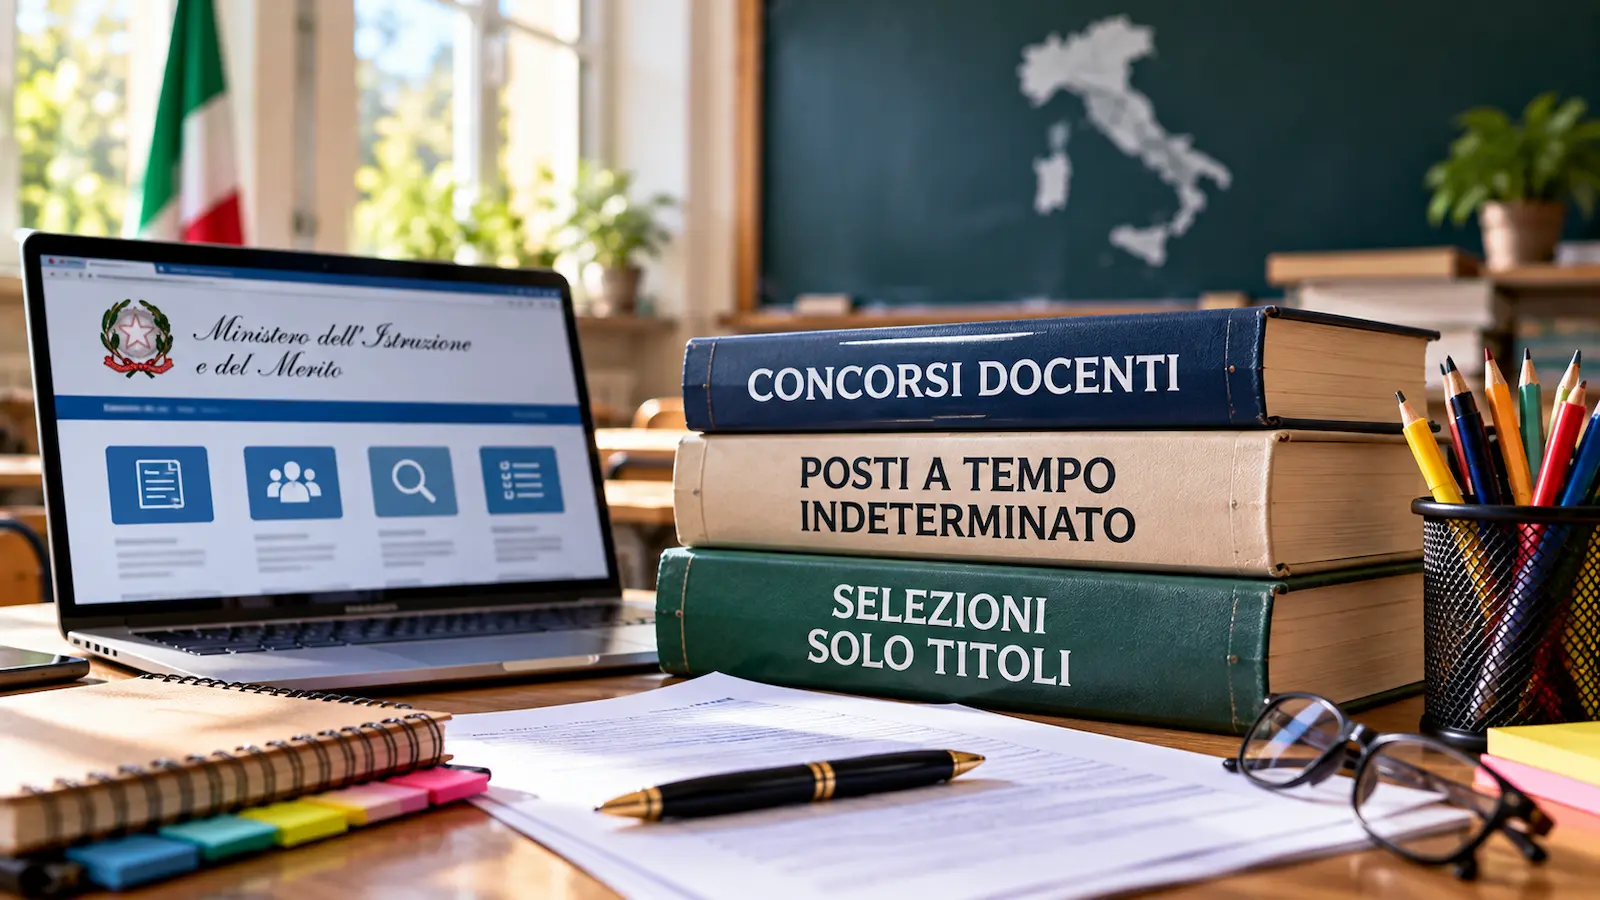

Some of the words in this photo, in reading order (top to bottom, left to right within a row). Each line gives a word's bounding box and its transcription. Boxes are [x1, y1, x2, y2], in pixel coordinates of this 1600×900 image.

[192, 314, 310, 346] Ministero
[195, 362, 207, 375] e
[214, 353, 254, 376] del
[257, 350, 343, 379] Merito
[747, 361, 963, 402] CONCORSI
[978, 353, 1180, 397] DOCENTI
[800, 456, 910, 490] POSTI
[922, 456, 952, 491] A
[962, 456, 1116, 494] TEMPO
[800, 500, 1136, 544] INDETERMINATO
[831, 583, 1047, 635] SELEZIONI
[807, 628, 914, 671] SOLO
[927, 637, 1072, 687] TITOLI
